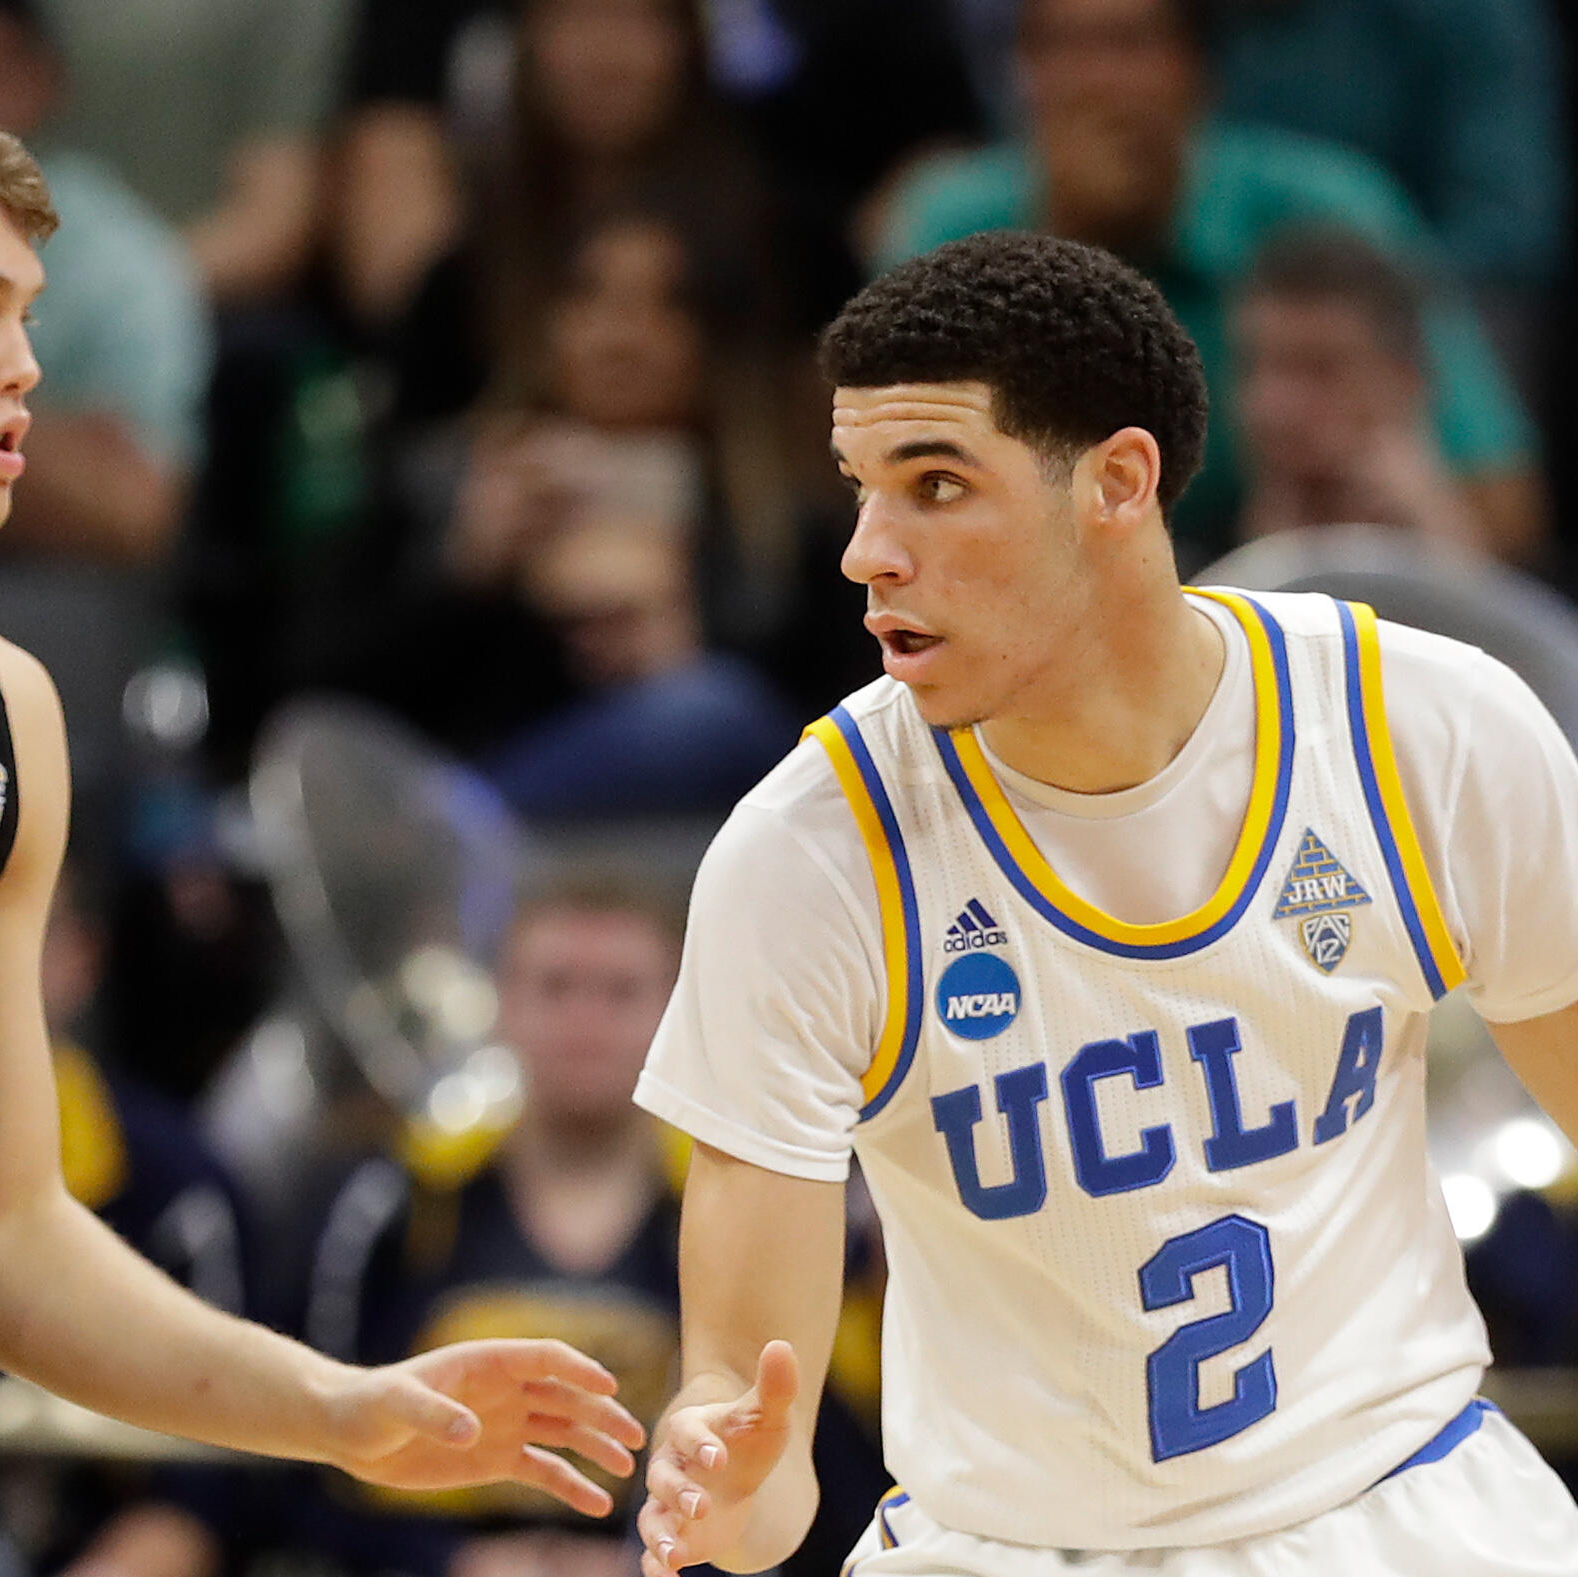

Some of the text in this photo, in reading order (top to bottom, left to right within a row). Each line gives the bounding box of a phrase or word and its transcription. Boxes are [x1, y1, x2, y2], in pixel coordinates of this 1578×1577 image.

[1288, 873, 1347, 904] JRW
[943, 930, 1007, 953] adidas
[946, 993, 1017, 1020] NCAA
[930, 1005, 1384, 1221] UCLA
[1138, 1213, 1278, 1464] 2
